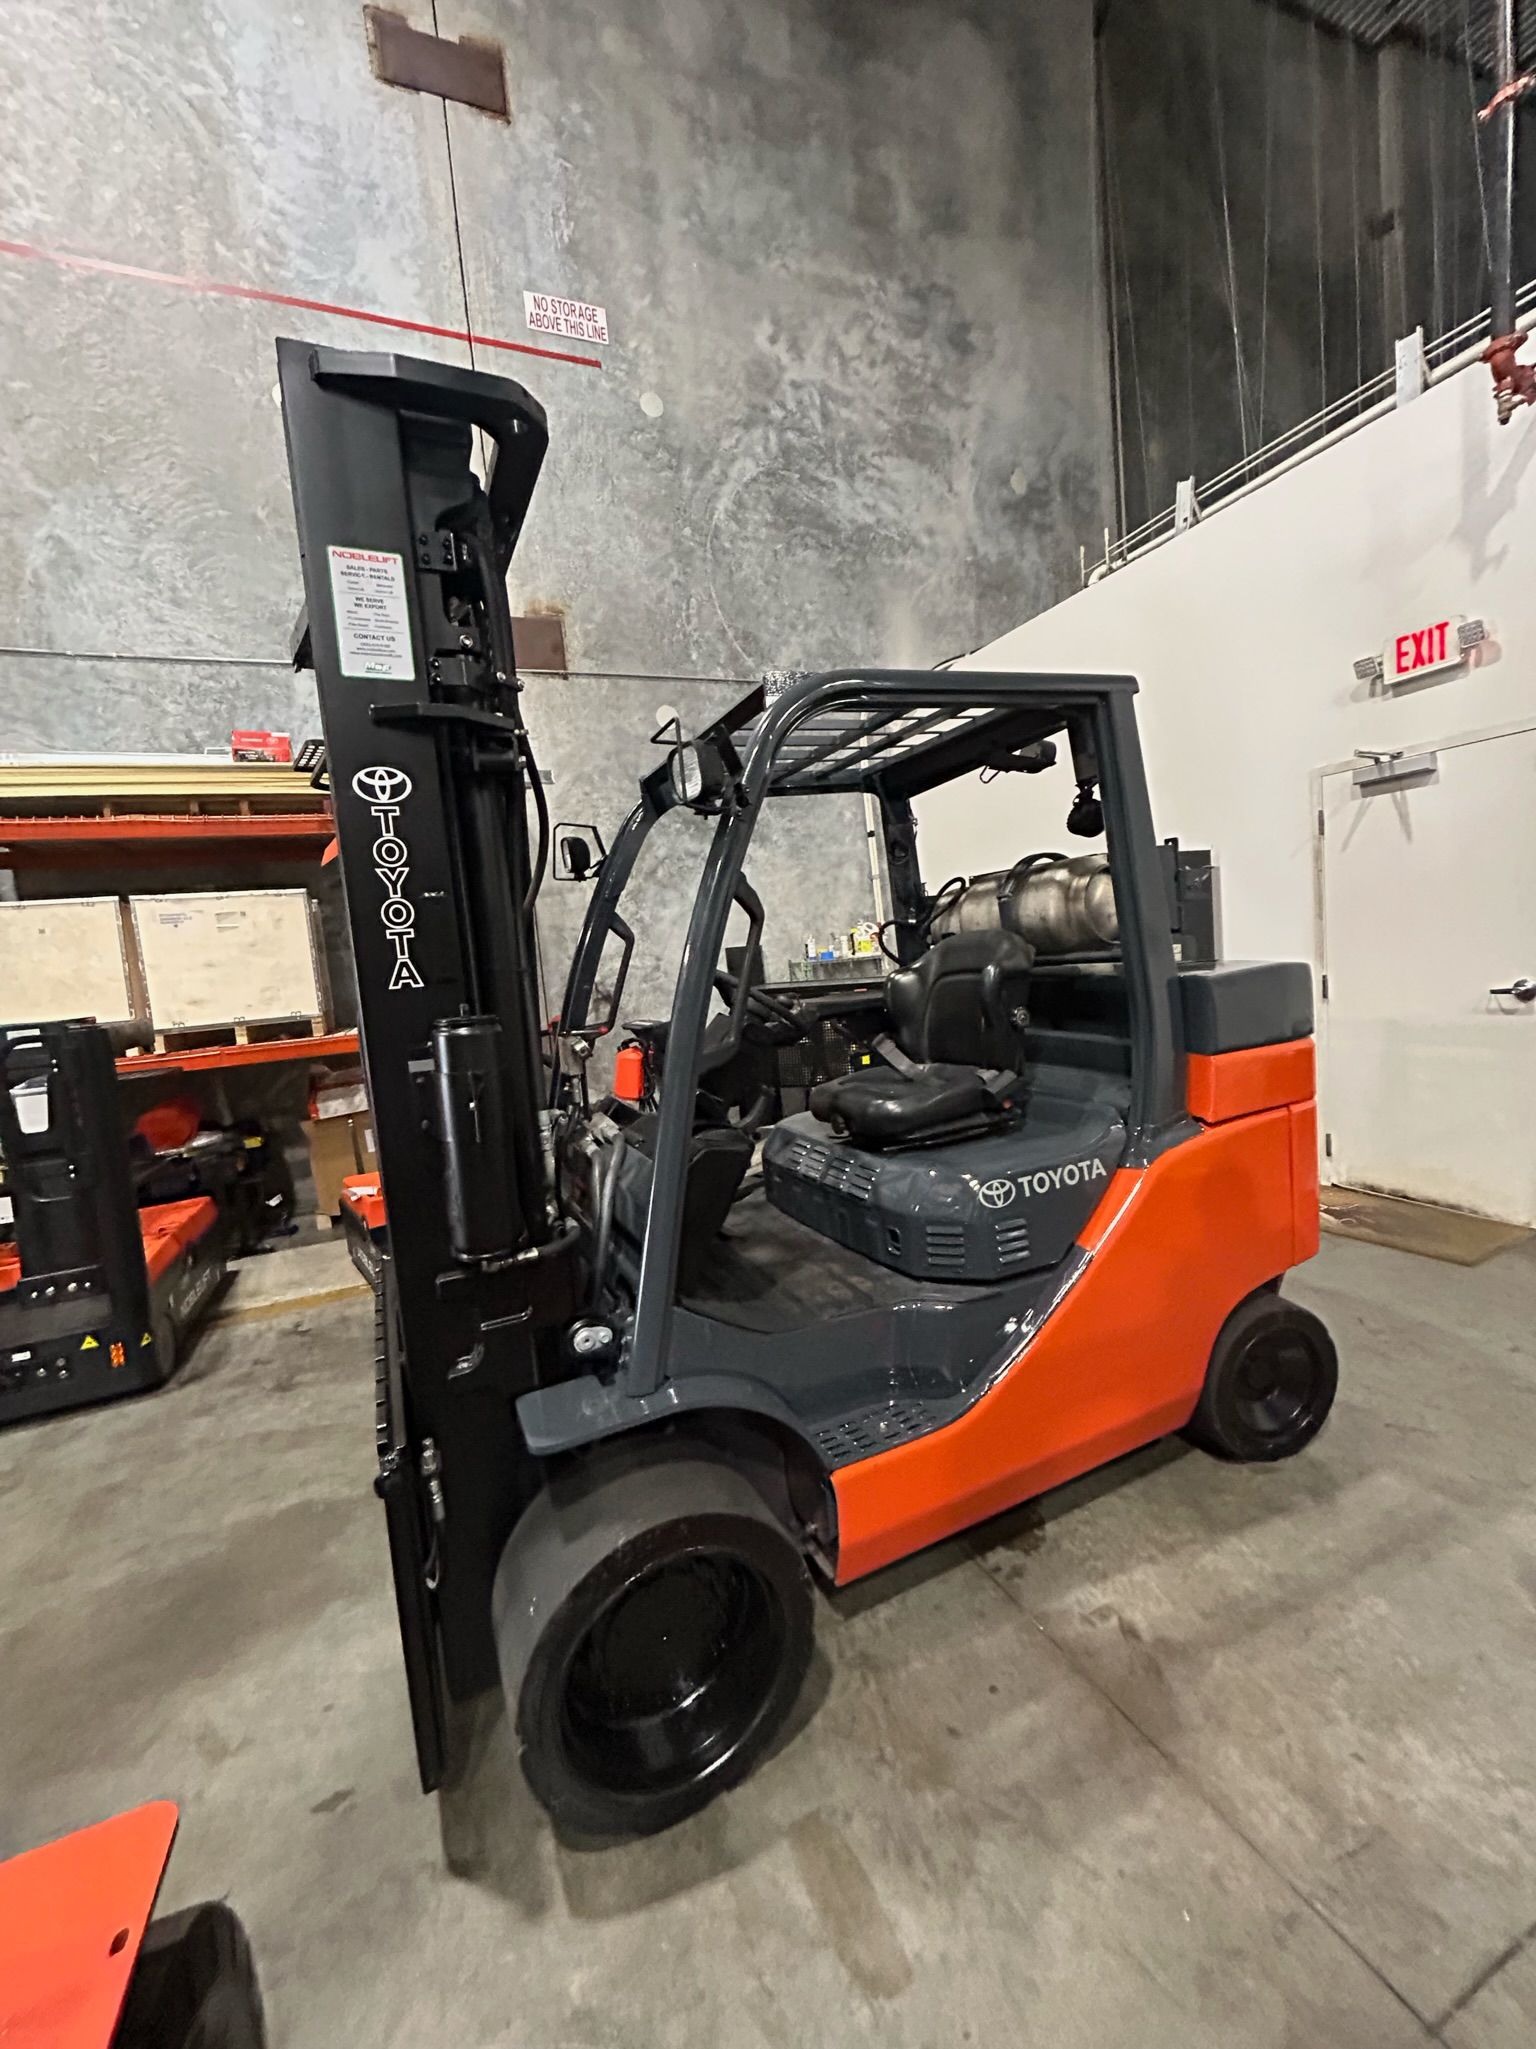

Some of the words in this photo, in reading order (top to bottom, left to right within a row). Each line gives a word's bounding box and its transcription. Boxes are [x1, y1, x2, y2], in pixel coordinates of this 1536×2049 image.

[533, 295, 548, 312] NO
[550, 299, 599, 323] STORAGE
[529, 312, 562, 332] ABOVE
[563, 318, 585, 337] THIS
[586, 324, 607, 342] LINE
[353, 633, 384, 641] CONTACT
[1396, 621, 1449, 674] EXIT
[371, 806, 424, 990] TOYOTA
[1017, 1158, 1107, 1197] TOYOTA
